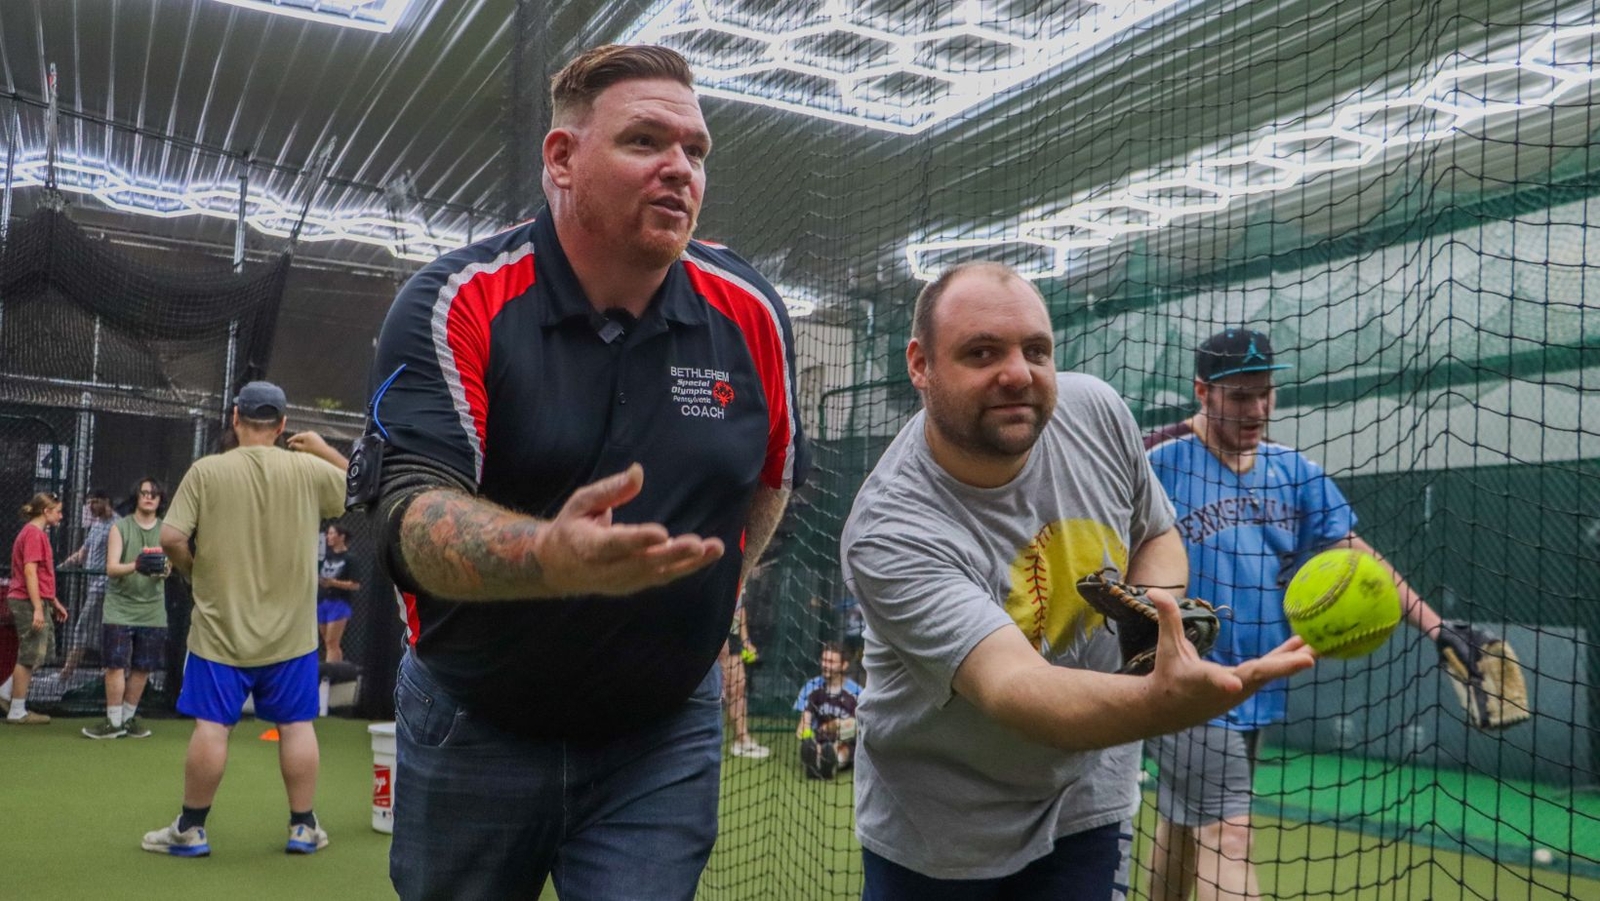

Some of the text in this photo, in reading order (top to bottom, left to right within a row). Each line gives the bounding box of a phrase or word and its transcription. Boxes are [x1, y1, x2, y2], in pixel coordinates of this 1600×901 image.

[671, 366, 729, 382] BETHLEHEM
[677, 379, 710, 387] Special
[671, 386, 712, 396] Olympics
[681, 405, 725, 419] COACH
